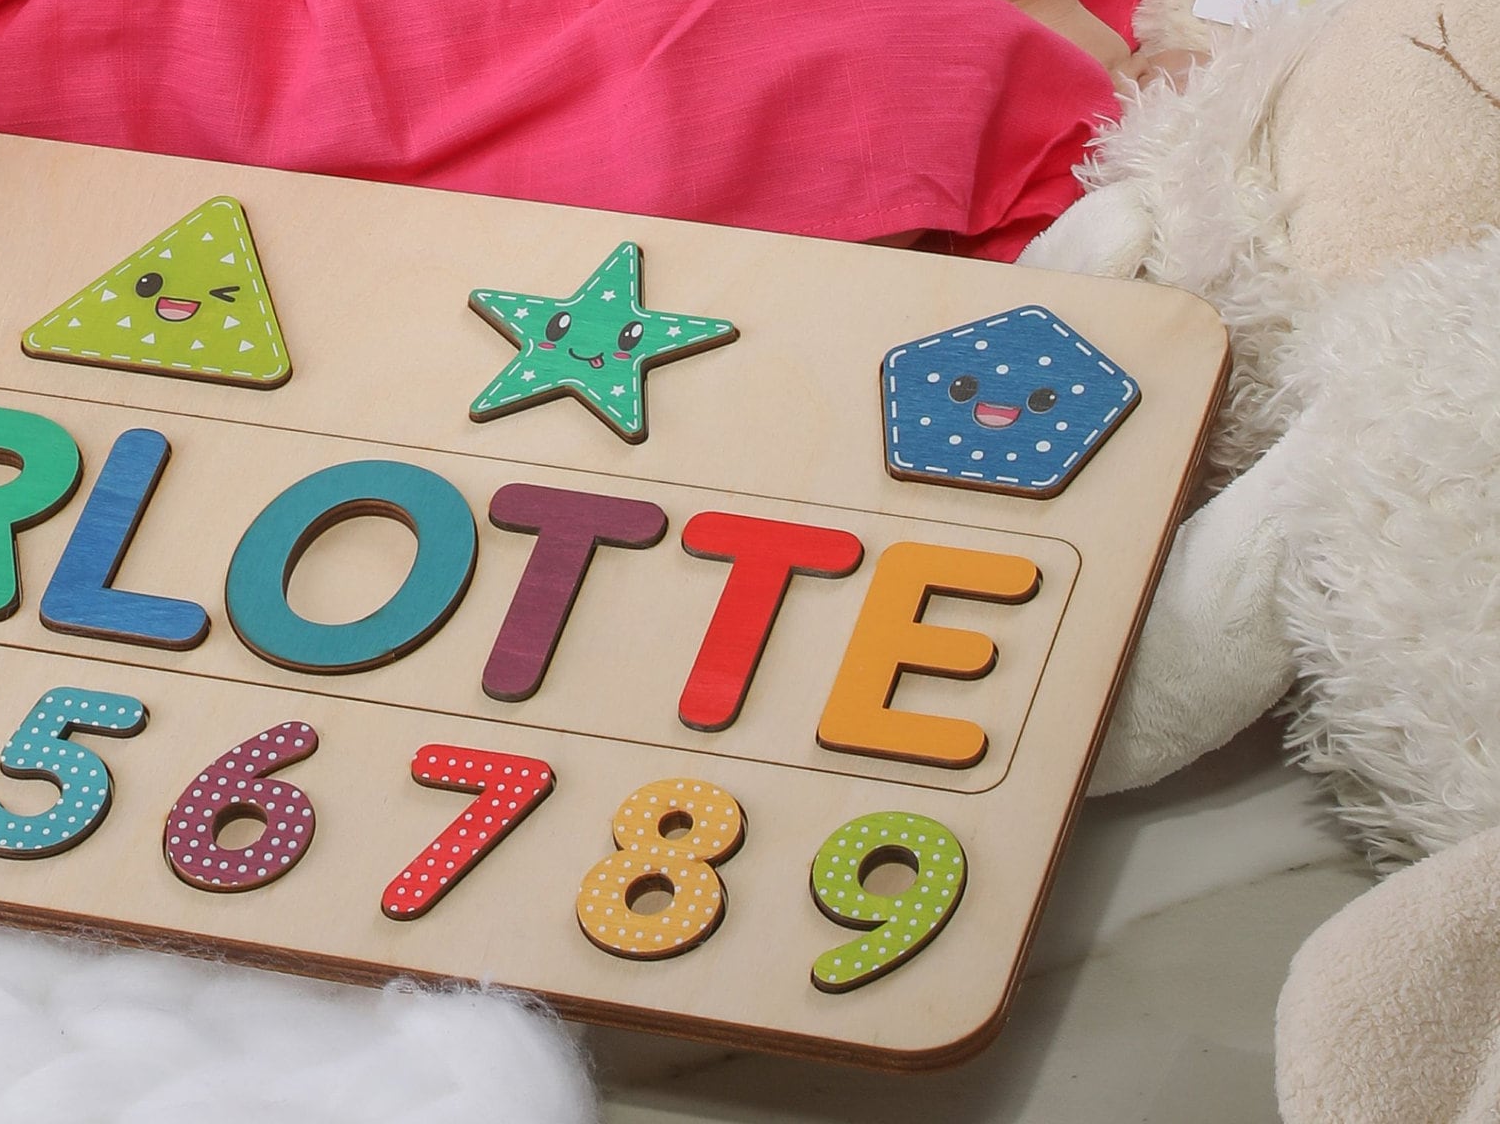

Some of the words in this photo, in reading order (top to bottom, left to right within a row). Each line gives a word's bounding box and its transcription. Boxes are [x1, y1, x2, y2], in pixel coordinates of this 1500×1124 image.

[163, 720, 320, 894] 6
[381, 743, 556, 922] 7
[576, 777, 746, 961] 8
[810, 810, 968, 994] 9
